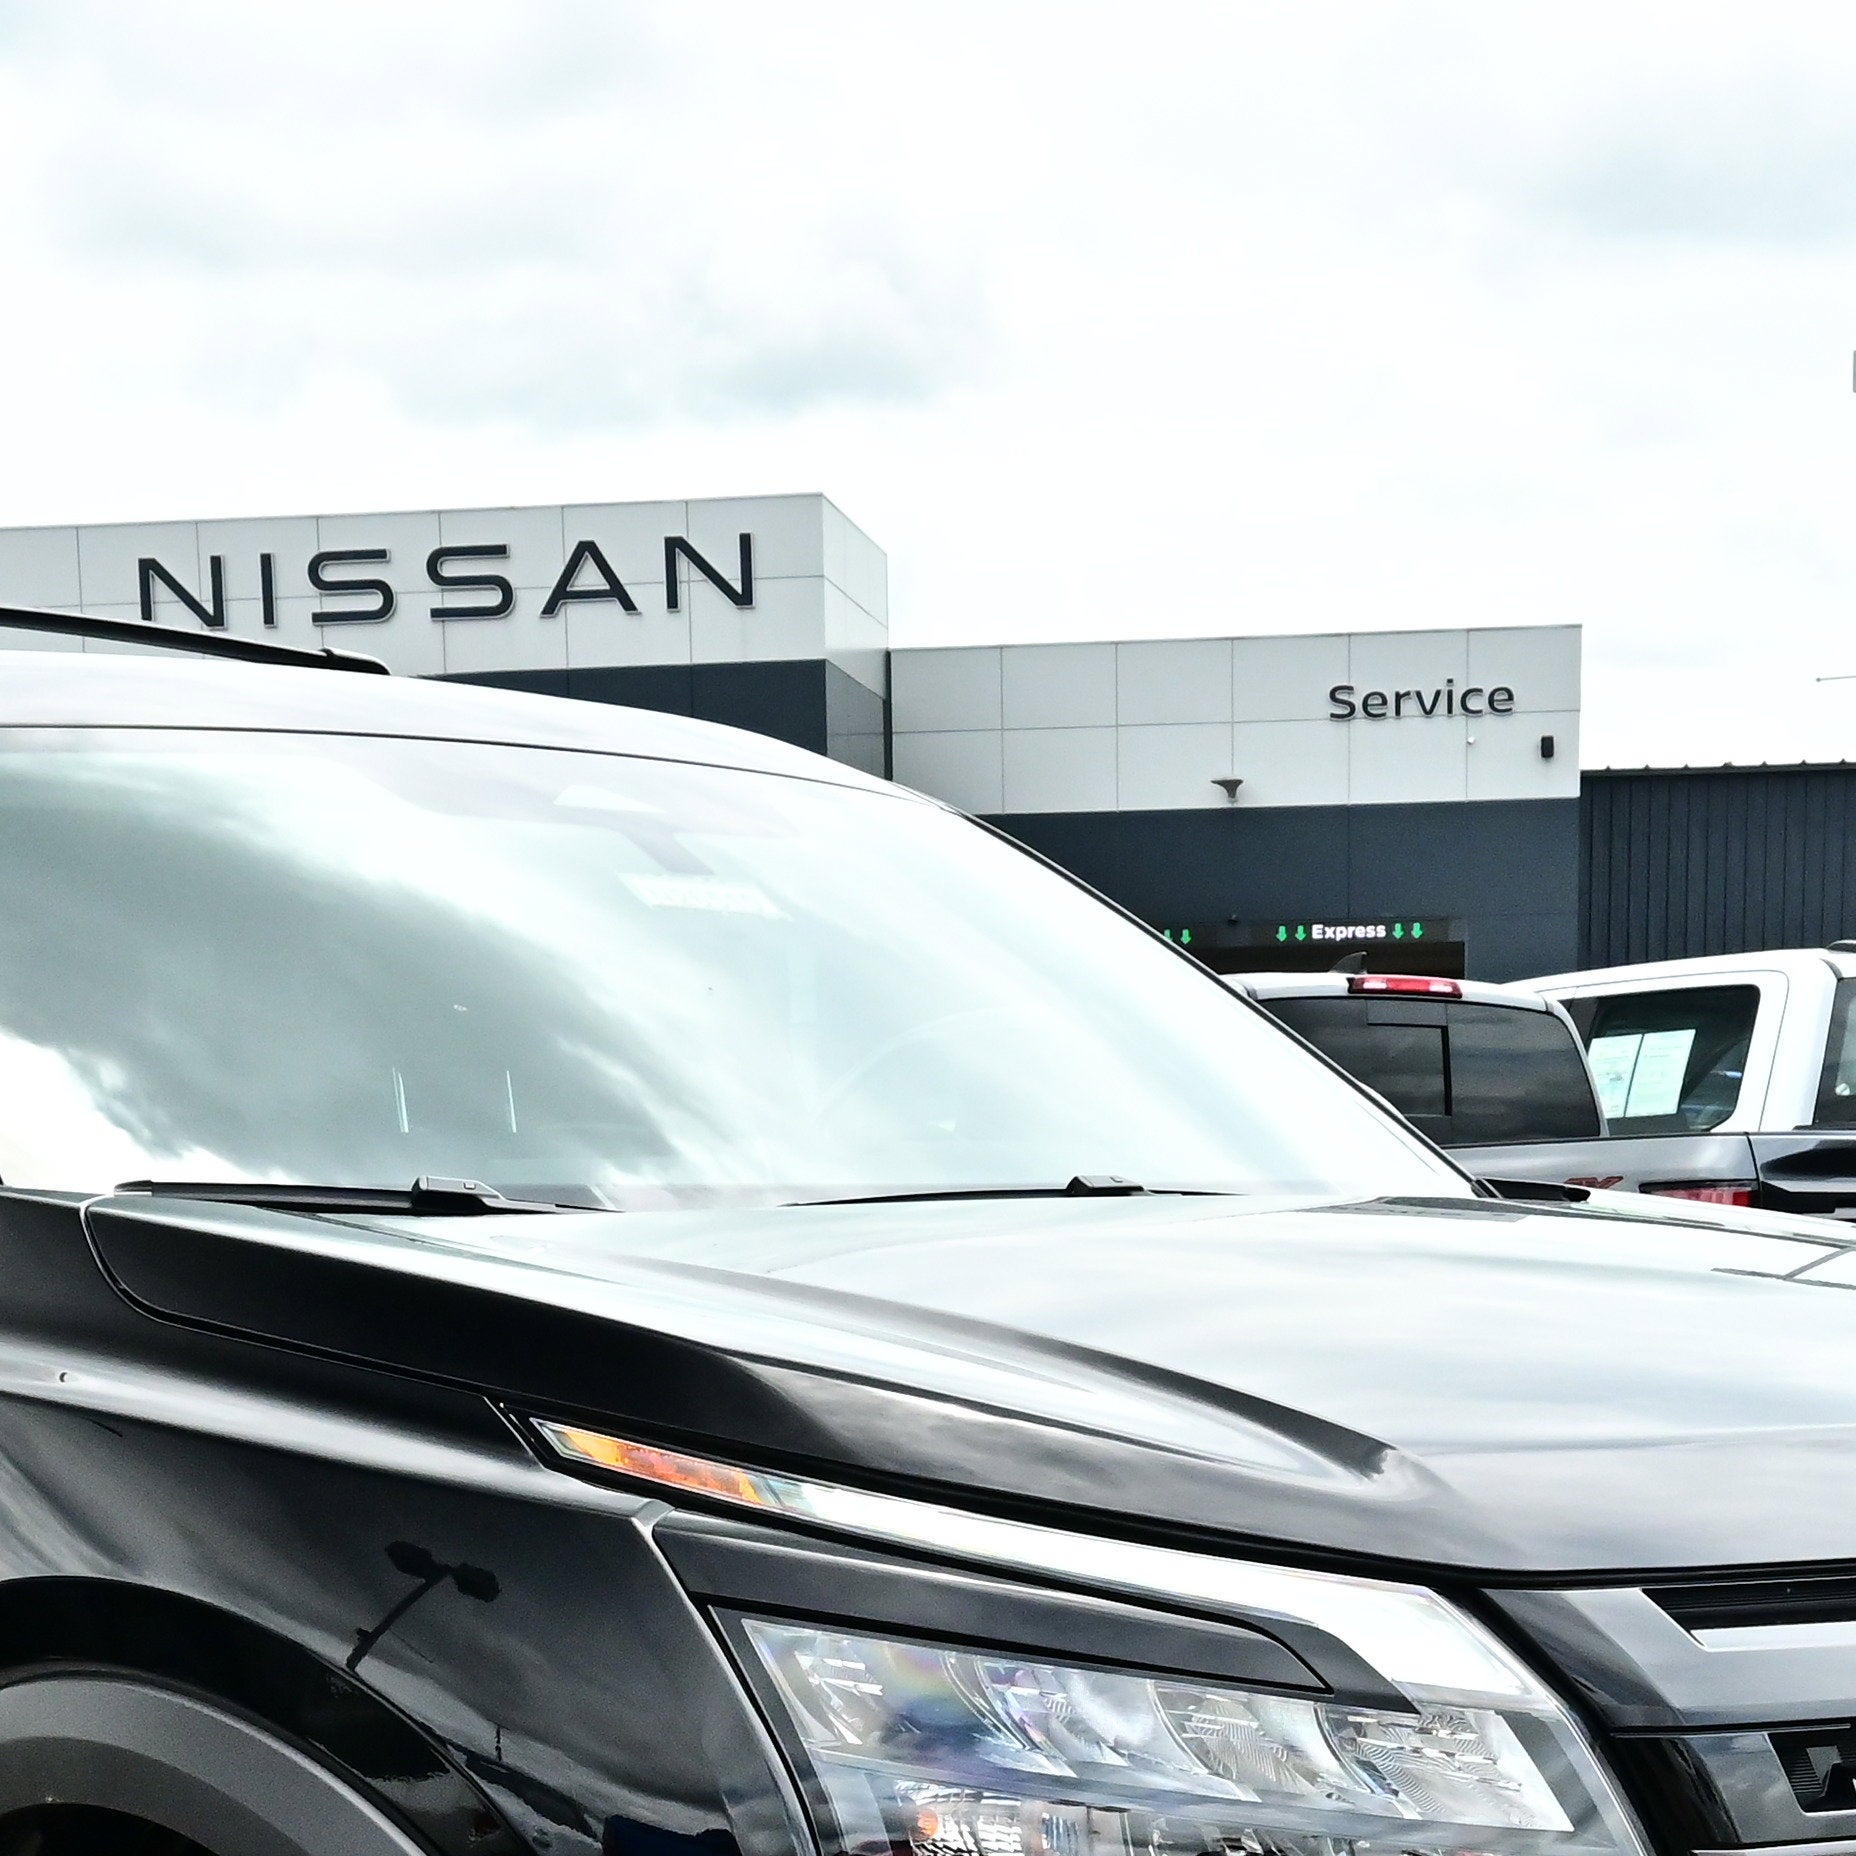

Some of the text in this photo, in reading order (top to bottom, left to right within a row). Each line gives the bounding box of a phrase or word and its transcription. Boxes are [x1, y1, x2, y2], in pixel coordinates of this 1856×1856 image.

[137, 531, 757, 629] NISSAN
[1328, 677, 1516, 721] Service
[1311, 921, 1387, 942] Express
